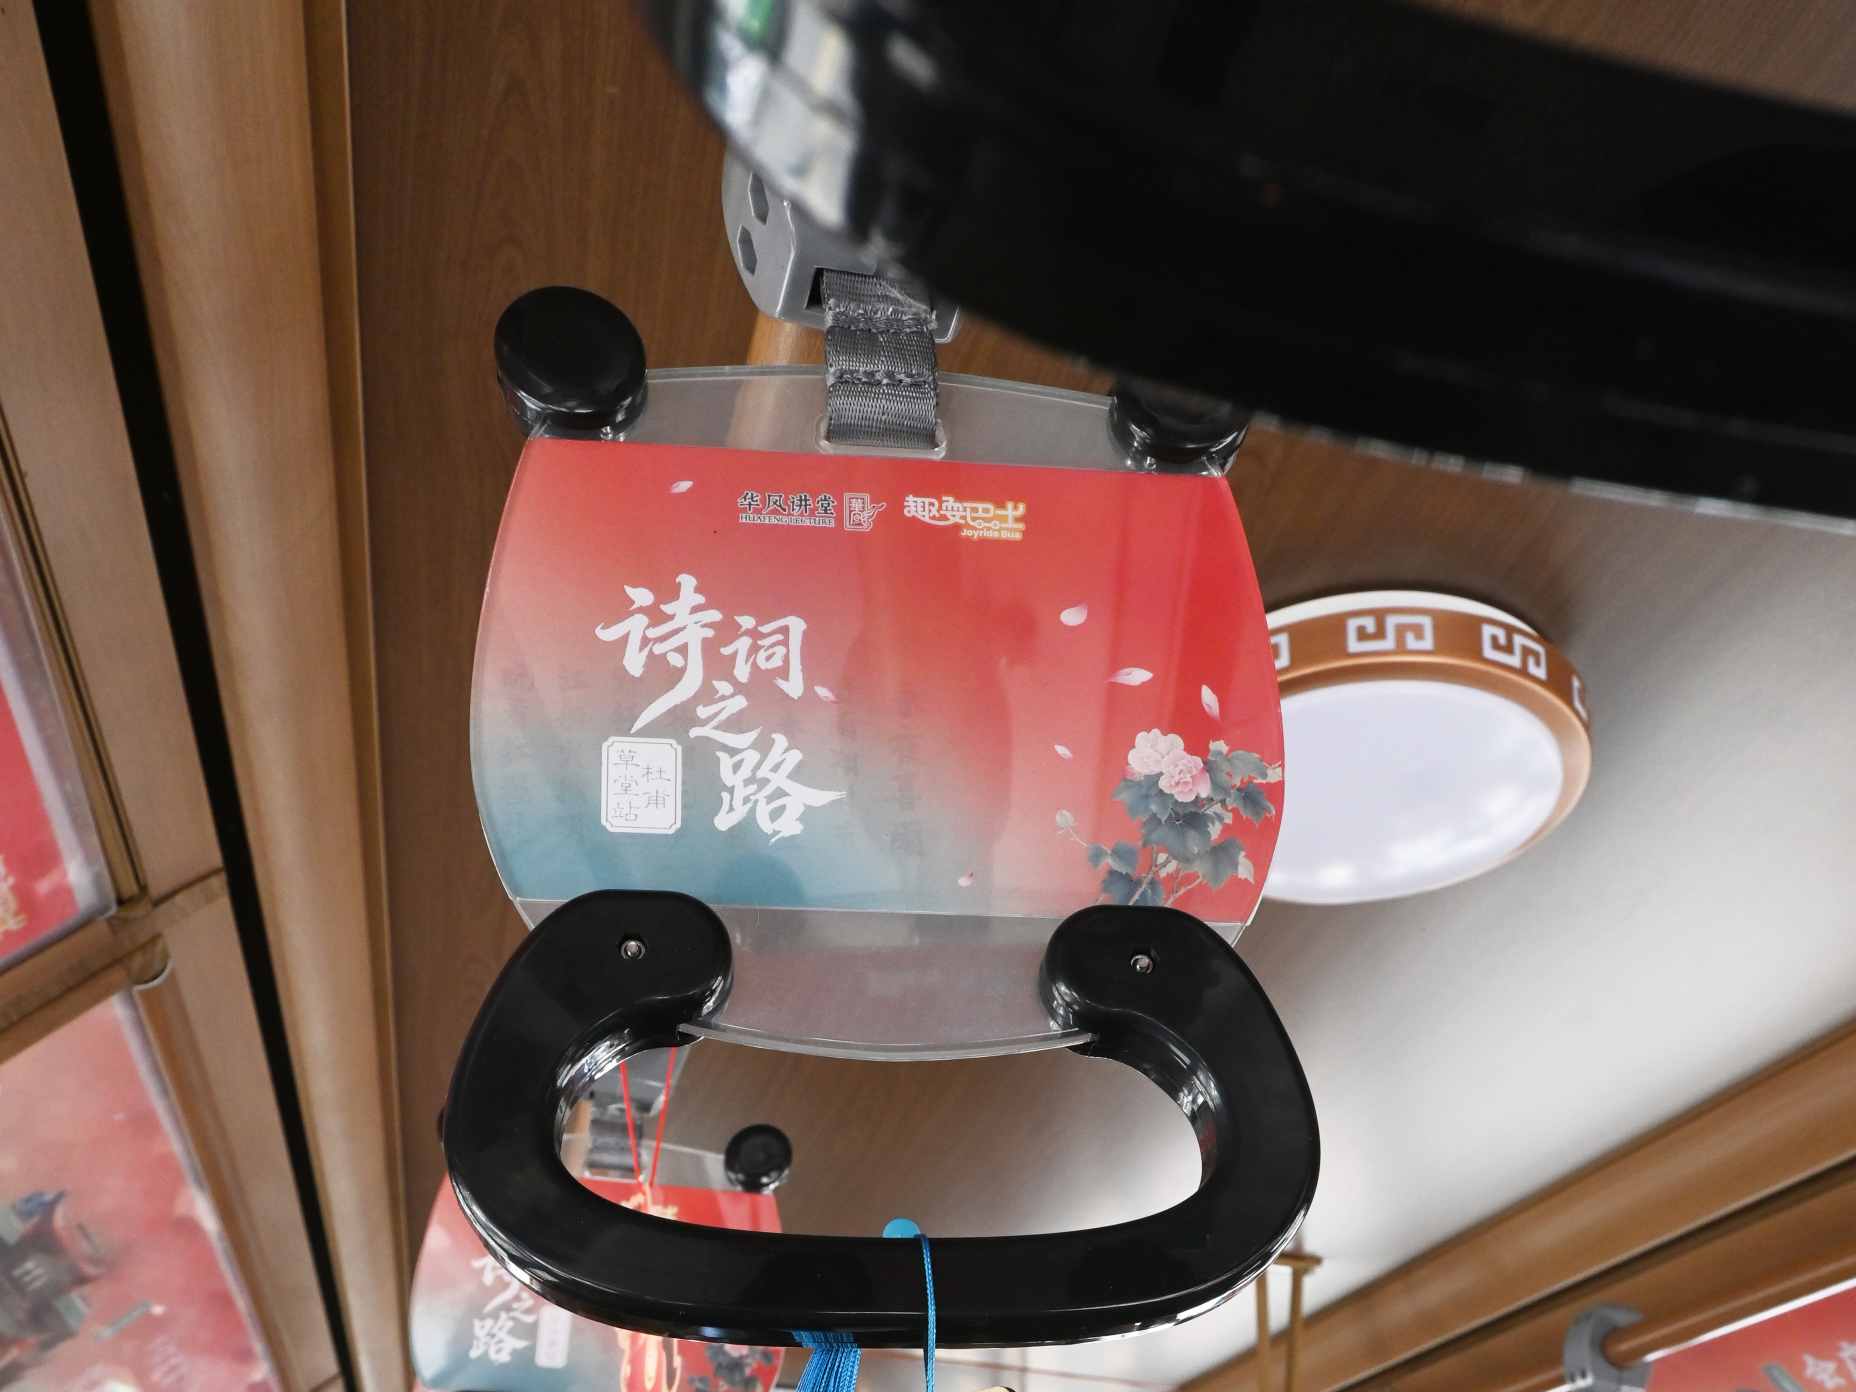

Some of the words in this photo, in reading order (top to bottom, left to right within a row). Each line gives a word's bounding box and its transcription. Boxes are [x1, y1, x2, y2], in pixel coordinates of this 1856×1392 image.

[738, 491, 835, 516] 华风讲堂
[595, 573, 848, 845] 诗词之路
